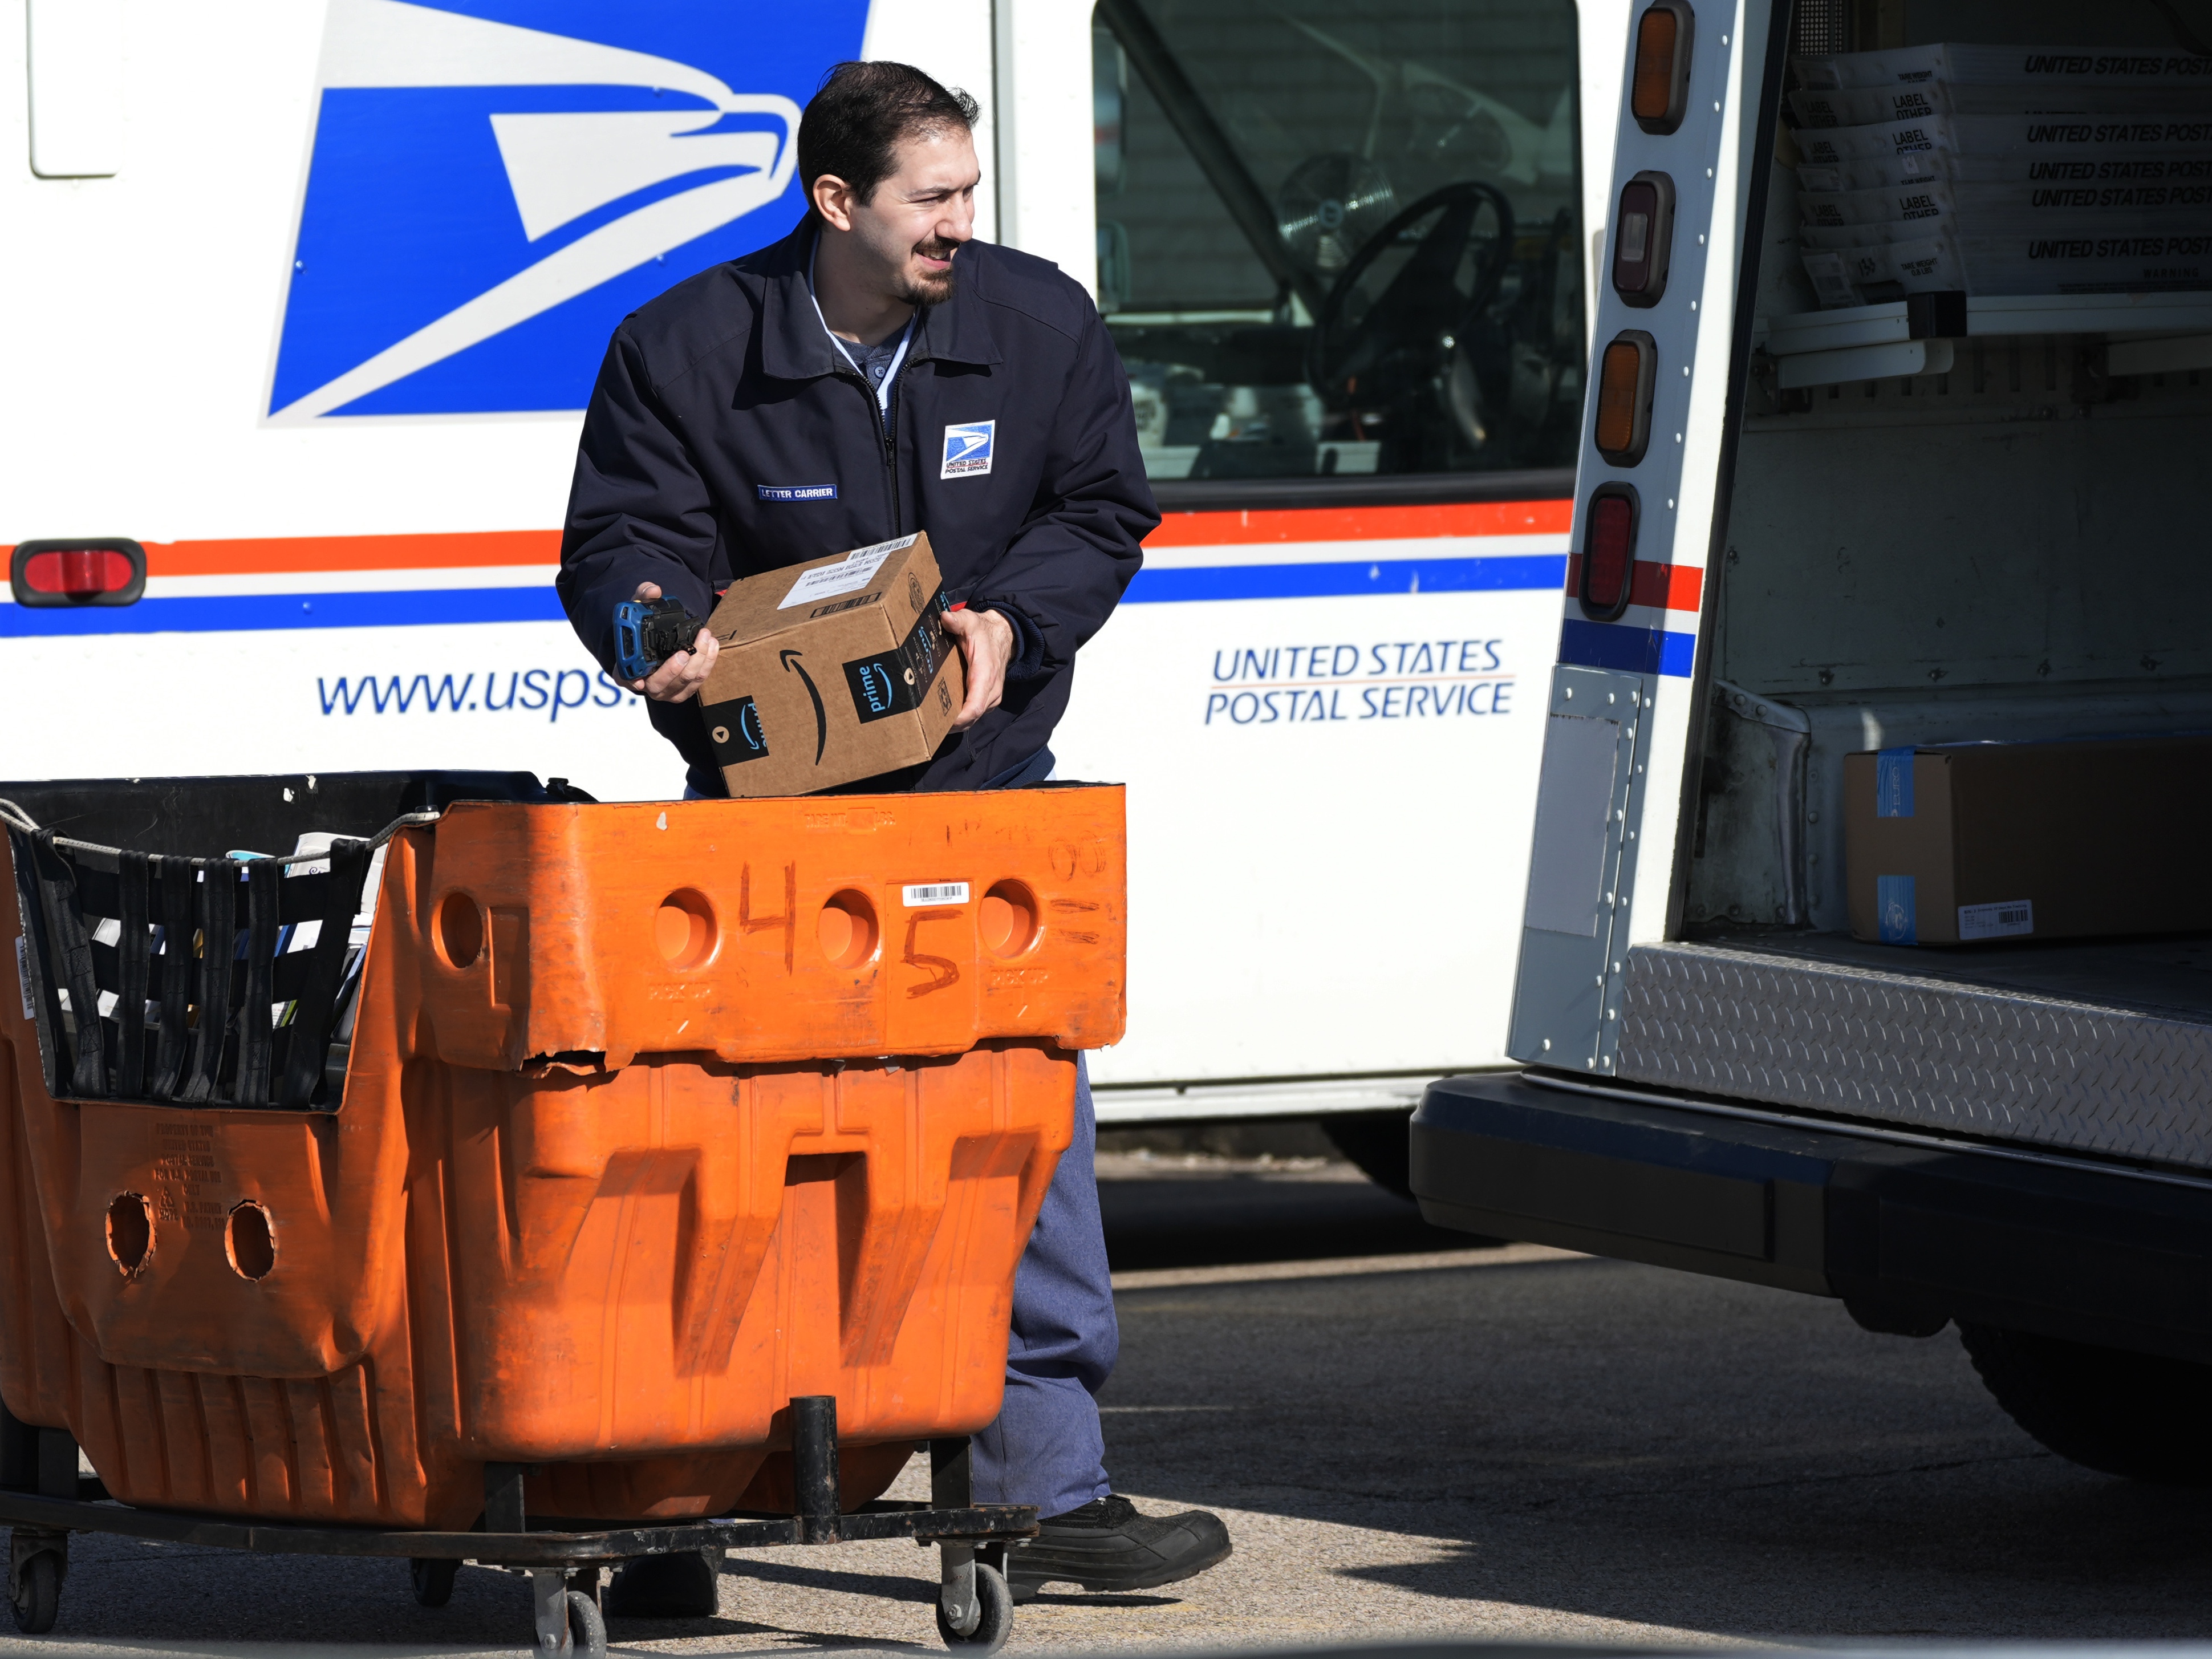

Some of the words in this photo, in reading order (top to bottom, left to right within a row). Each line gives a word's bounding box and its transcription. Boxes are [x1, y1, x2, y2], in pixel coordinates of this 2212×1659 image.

[2025, 55, 2093, 74] UNITED
[2095, 56, 2163, 75] STATES
[1805, 101, 1834, 113] LABEL
[1893, 93, 1929, 108] LABEL
[1893, 129, 1929, 145] LABEL
[2027, 125, 2092, 143] UNITED
[2095, 124, 2163, 143] STATES
[2165, 124, 2212, 142] POST
[1812, 141, 1836, 154] ABEL
[2029, 162, 2096, 180] UNITED
[2098, 161, 2165, 179] STATES
[1900, 195, 1935, 210] LABEL
[2032, 189, 2098, 206] UNITED
[2100, 187, 2167, 206] STATES
[1815, 204, 1841, 217] LABEL
[2029, 241, 2093, 259] UNITED
[2096, 238, 2164, 257] STATES
[1901, 262, 1915, 271] TARE
[1915, 258, 1938, 269] WEIGHT
[2143, 267, 2199, 279] WARNING
[762, 489, 792, 498] LETTER
[794, 488, 833, 498] CARRIER
[1213, 644, 1360, 682] UNITED
[1367, 639, 1502, 675] STATES
[859, 666, 886, 712] prime
[1205, 688, 1348, 725] POSTAL
[1359, 682, 1515, 720] SERVICE
[740, 859, 797, 978] 4
[900, 908, 964, 1000] 5
[991, 969, 1025, 985] PICK
[1027, 968, 1049, 984] UP
[648, 983, 685, 1000] PICK
[688, 981, 711, 999] UP
